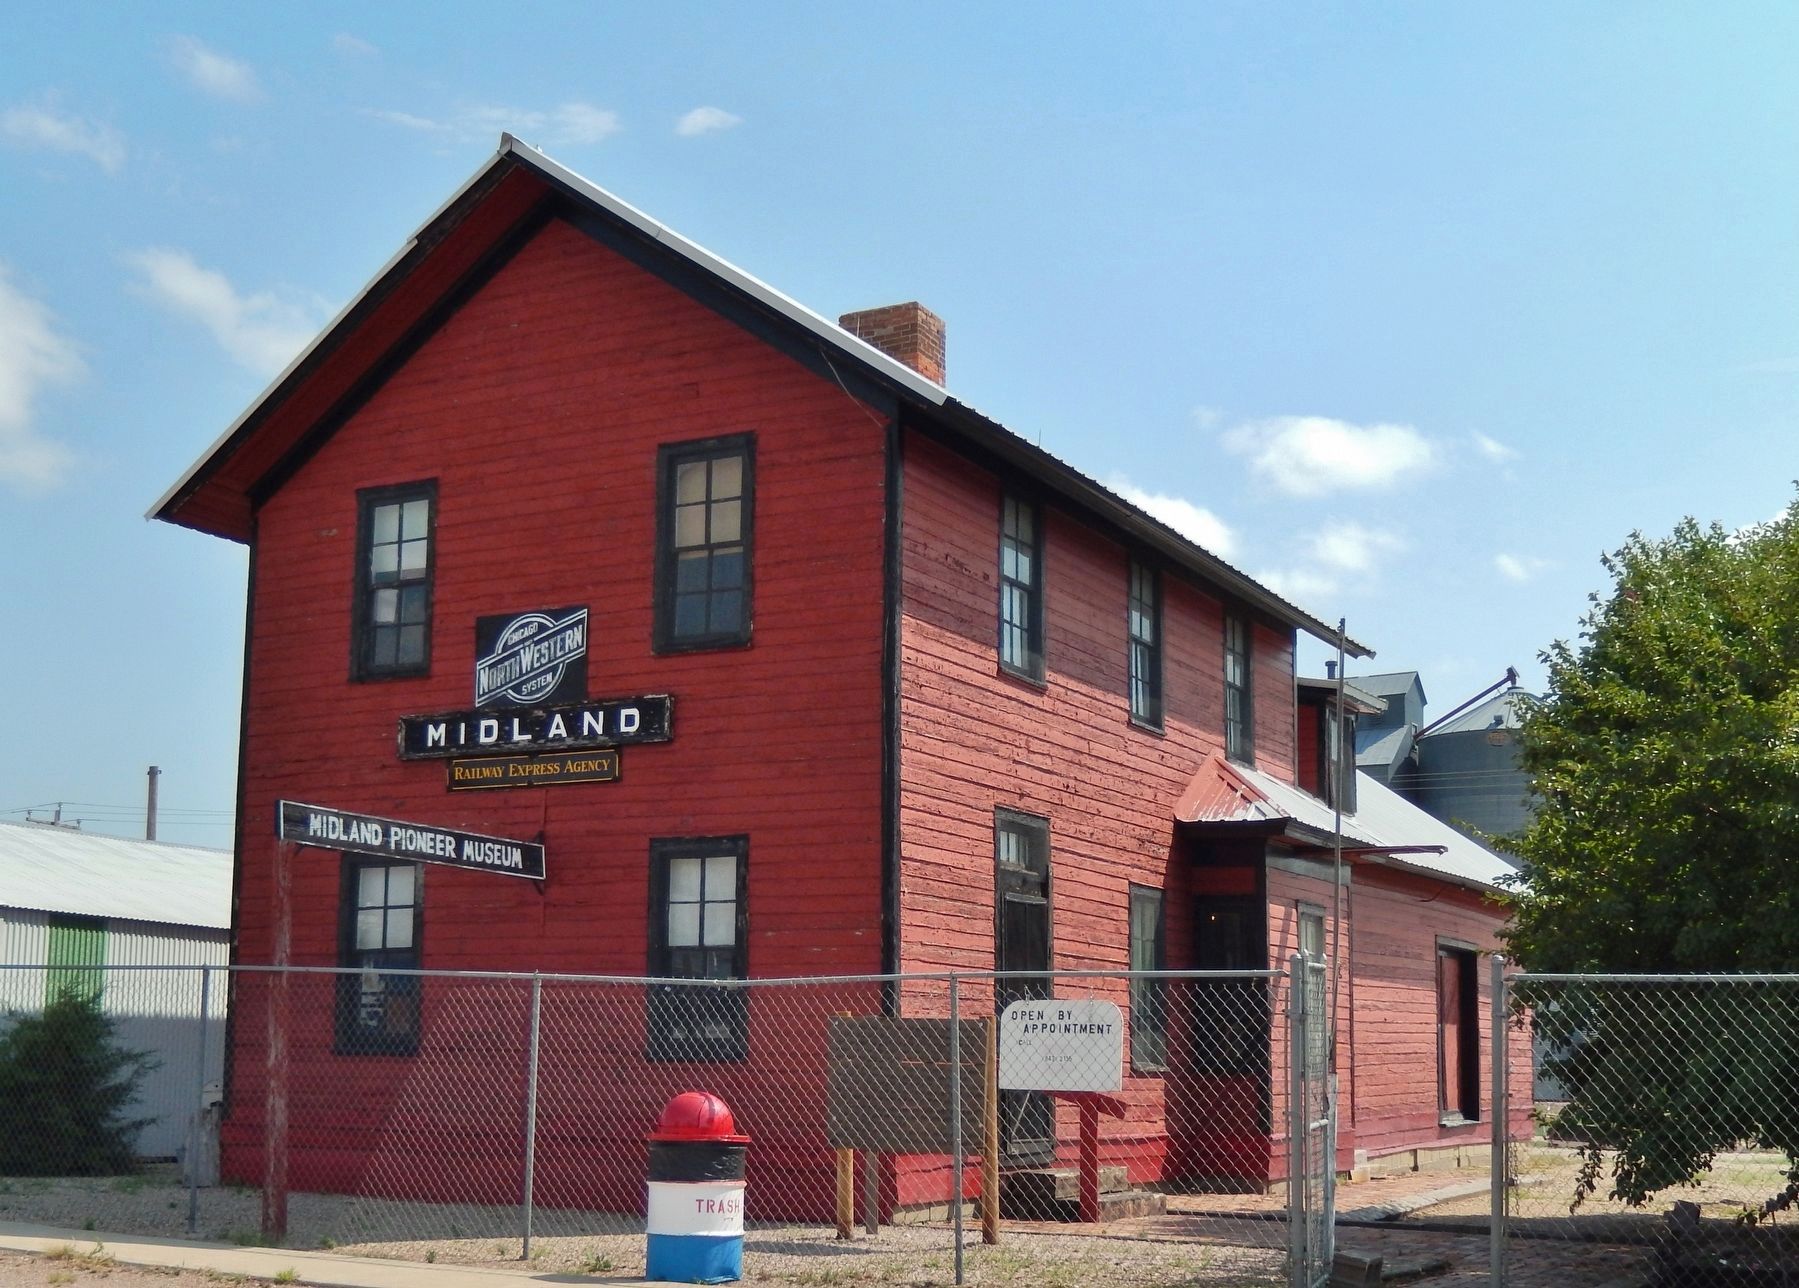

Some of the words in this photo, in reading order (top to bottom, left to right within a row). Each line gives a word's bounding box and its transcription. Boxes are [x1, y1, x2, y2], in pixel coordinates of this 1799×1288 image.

[507, 622, 539, 646] CHICAGO
[522, 672, 554, 695] SYSTEM
[427, 707, 640, 747] MIDLAND
[454, 766, 505, 781] RAILWAY
[509, 762, 561, 778] EXPRESS
[564, 758, 611, 774] AGENCY
[309, 813, 383, 846] MIDLAND
[389, 825, 457, 859] PIONEER
[462, 839, 523, 869] MUSEUM
[1011, 1010, 1044, 1020] OPEN
[1058, 1010, 1072, 1020] BY
[1023, 1023, 1112, 1034] APPOINTMENT
[696, 1199, 740, 1213] TRASH
